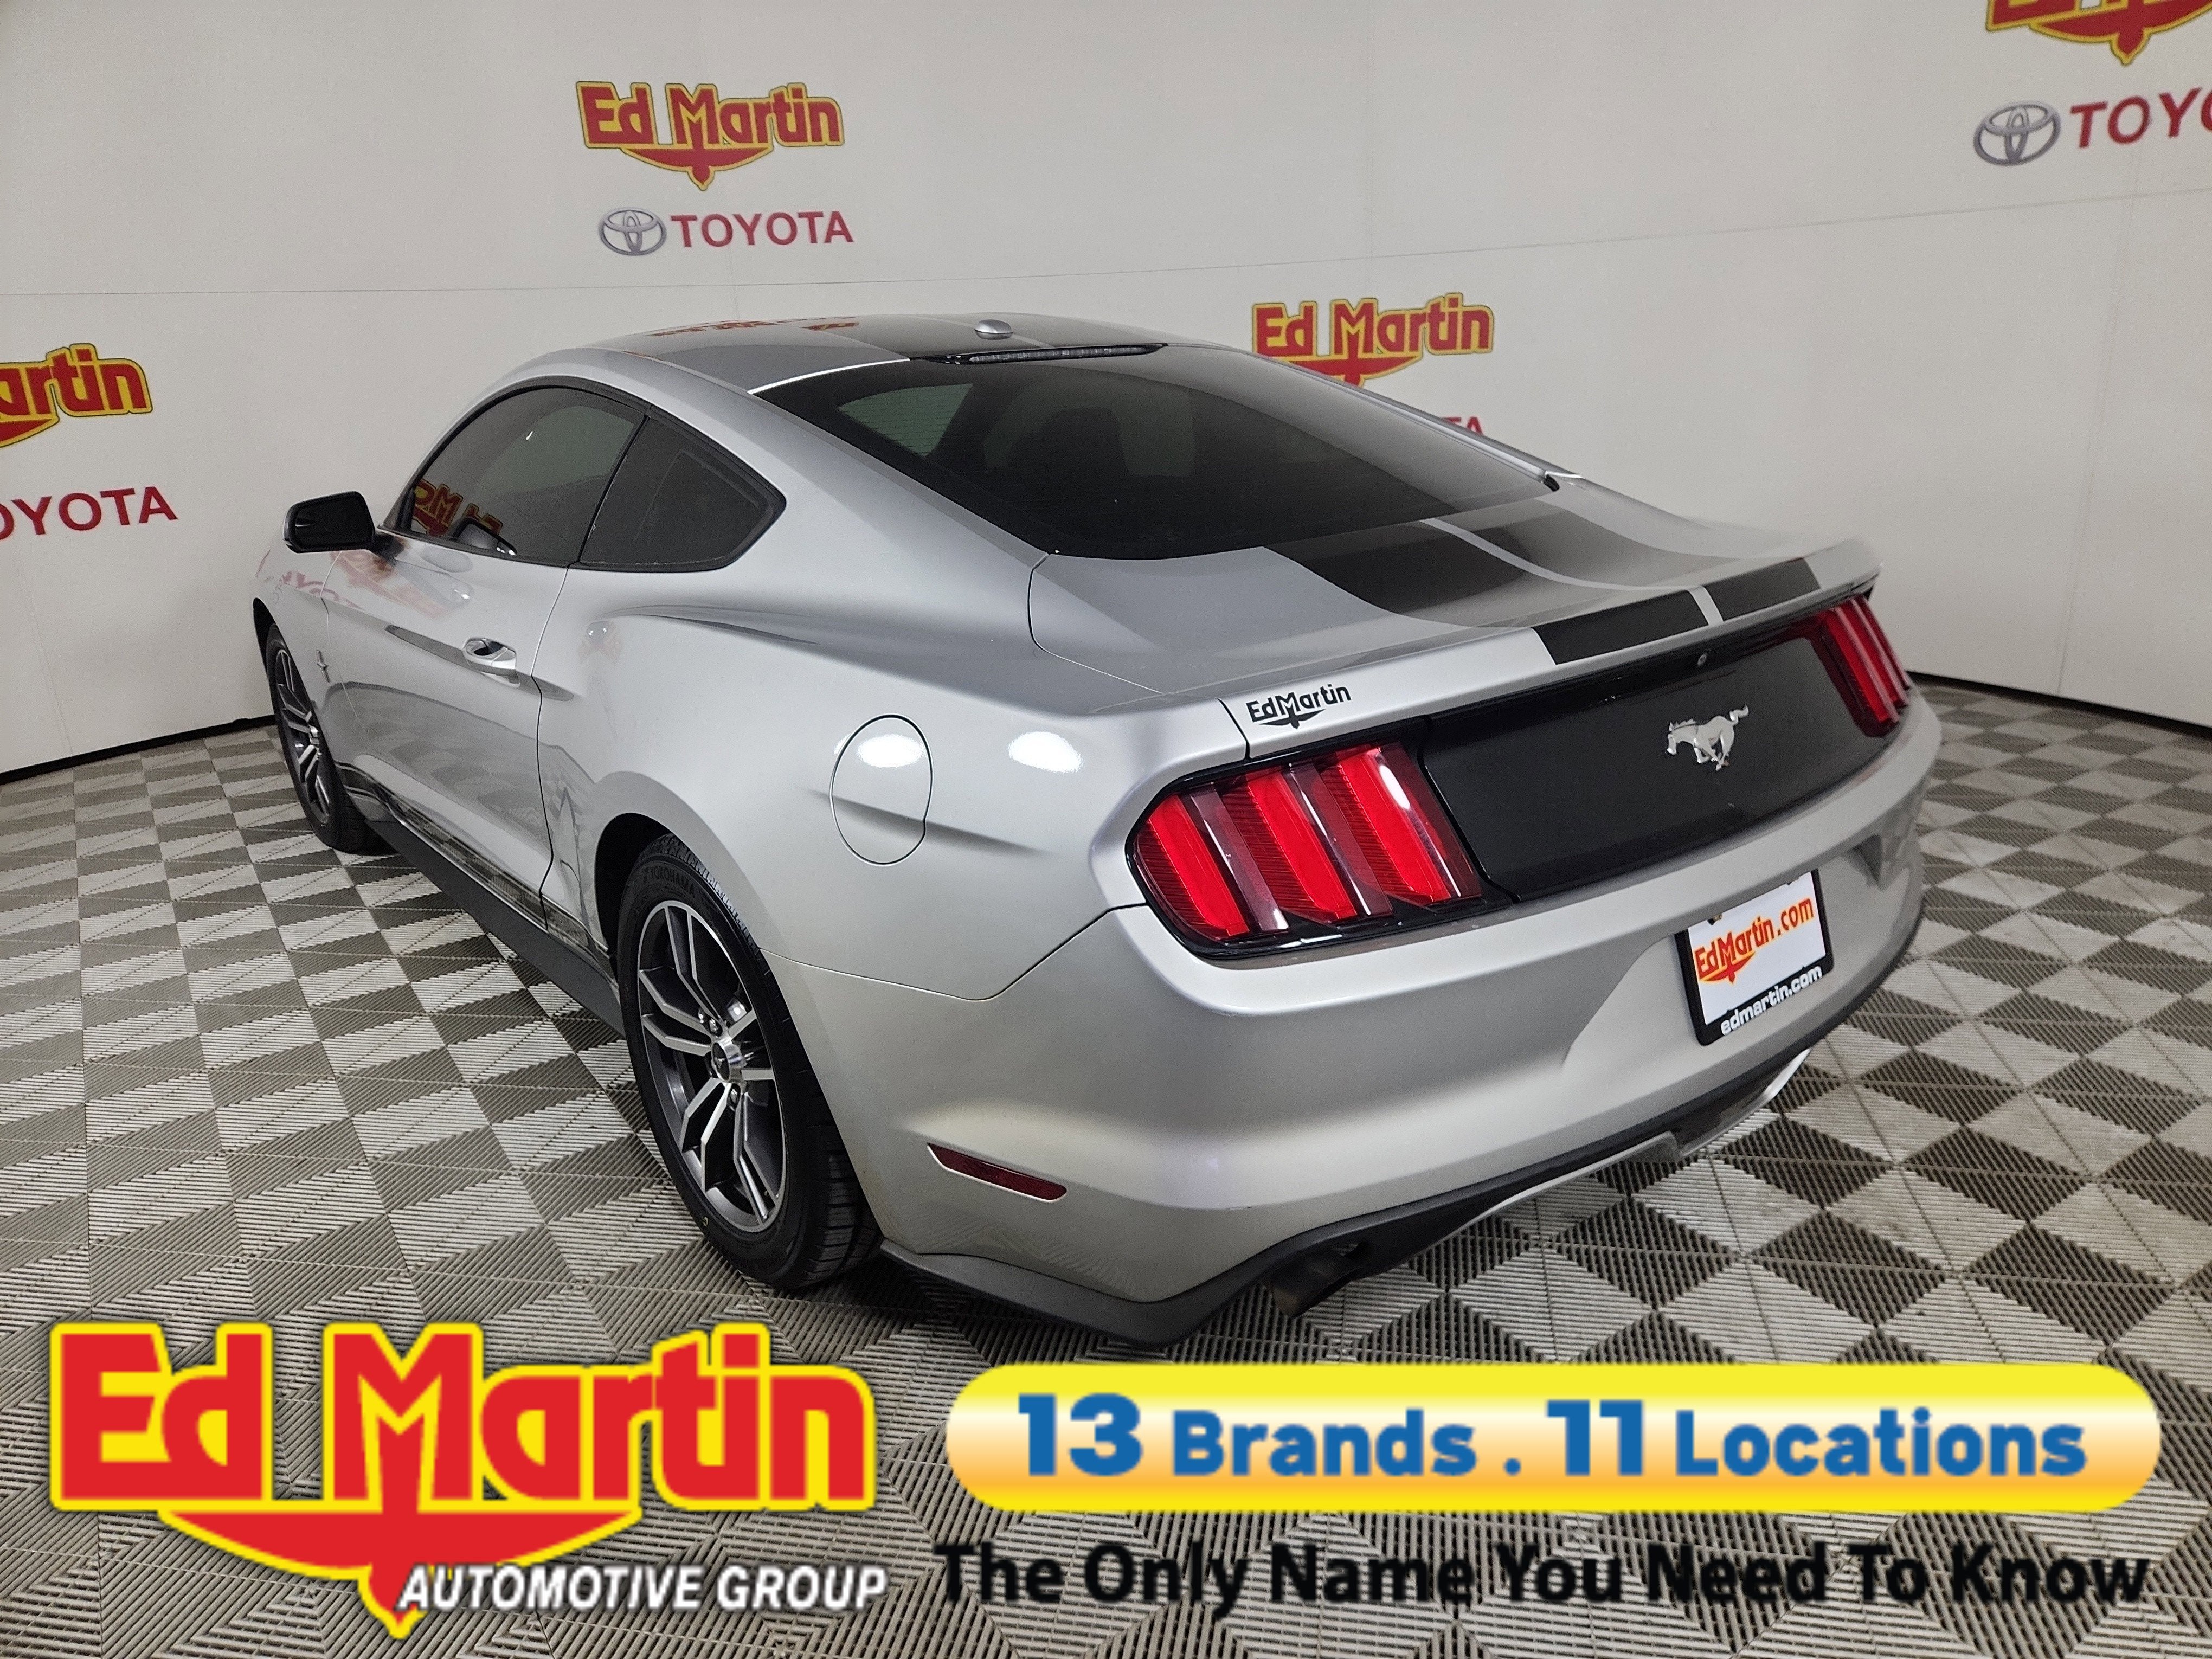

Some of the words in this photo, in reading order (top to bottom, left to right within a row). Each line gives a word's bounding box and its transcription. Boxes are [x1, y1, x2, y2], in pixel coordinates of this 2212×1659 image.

[577, 82, 656, 146] Ed
[666, 83, 844, 147] Martin
[2070, 87, 2212, 149] TOY
[670, 211, 854, 248] TOYOTA
[1253, 301, 1316, 356] Ed
[1330, 293, 1494, 355] Martin
[0, 486, 178, 541] YOTA
[650, 864, 696, 899] YOKOHAMA
[1721, 965, 1822, 1036] edmartin.com
